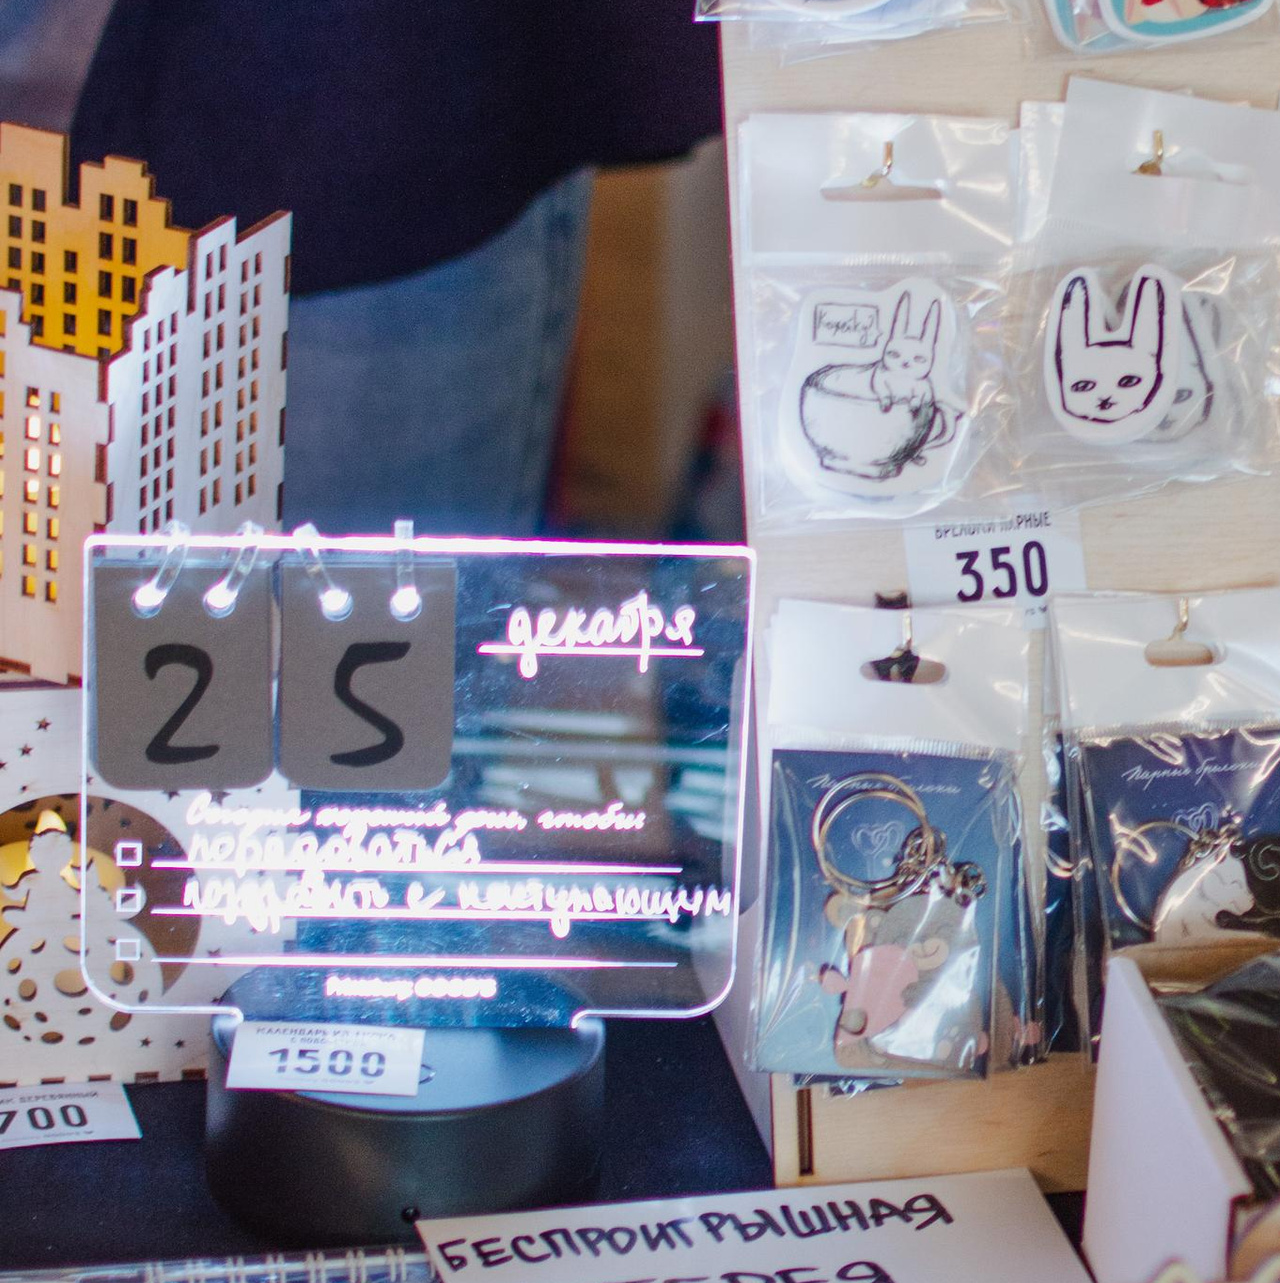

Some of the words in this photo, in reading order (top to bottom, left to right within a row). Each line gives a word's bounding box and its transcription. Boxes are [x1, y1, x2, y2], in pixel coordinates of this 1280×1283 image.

[956, 540, 1048, 604] 350
[268, 1047, 386, 1078] 1500
[437, 1192, 954, 1272] БЕСПРОИГРЫШНАЯ
